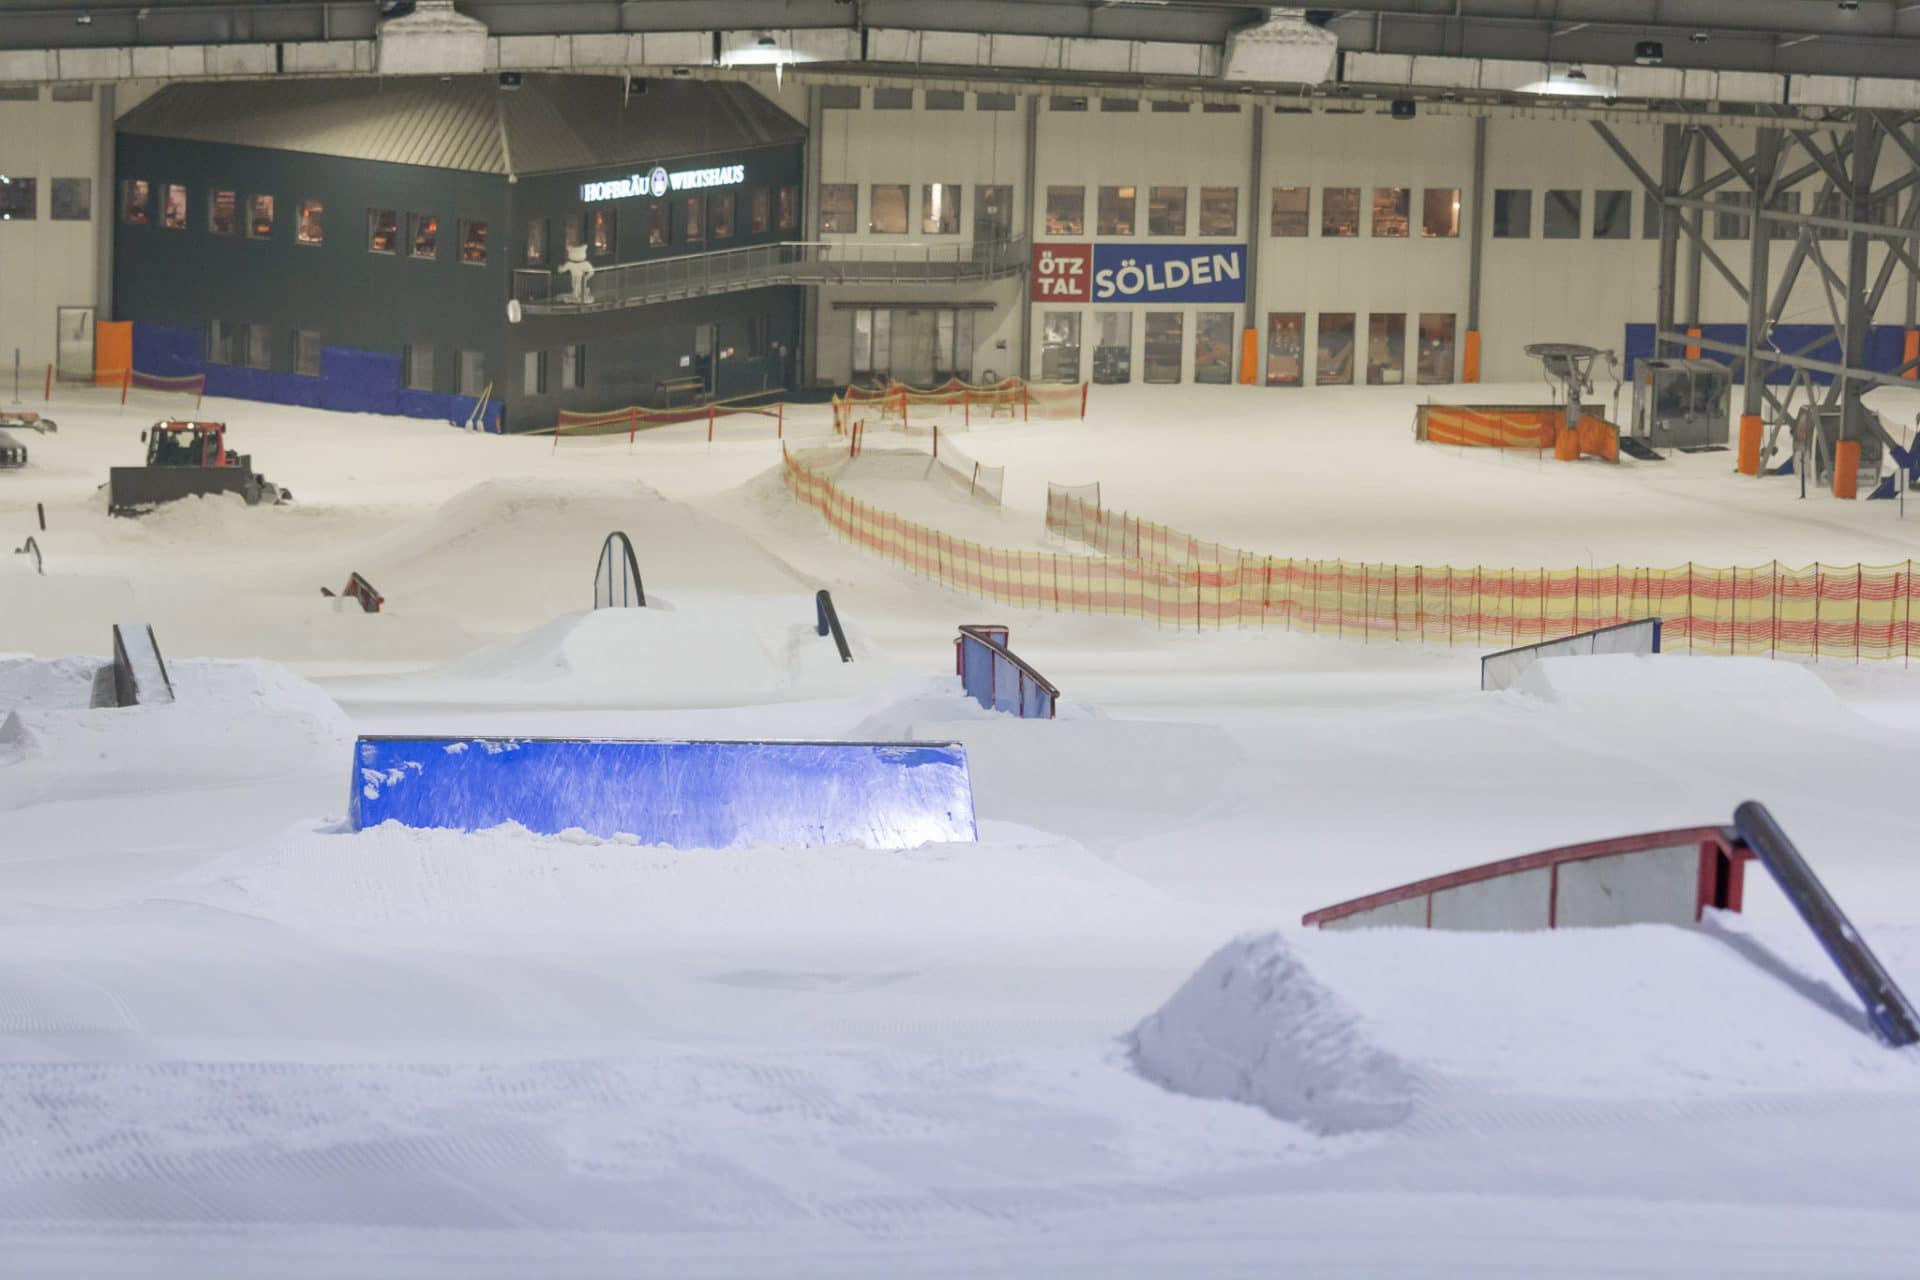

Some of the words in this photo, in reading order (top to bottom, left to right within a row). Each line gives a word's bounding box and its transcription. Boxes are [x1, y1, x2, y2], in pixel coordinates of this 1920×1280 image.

[669, 165, 745, 191] WIRTSHAUS
[1038, 251, 1084, 275] ÖTZ
[1095, 252, 1241, 298] SÖLDEN
[1038, 278, 1083, 295] TAL
